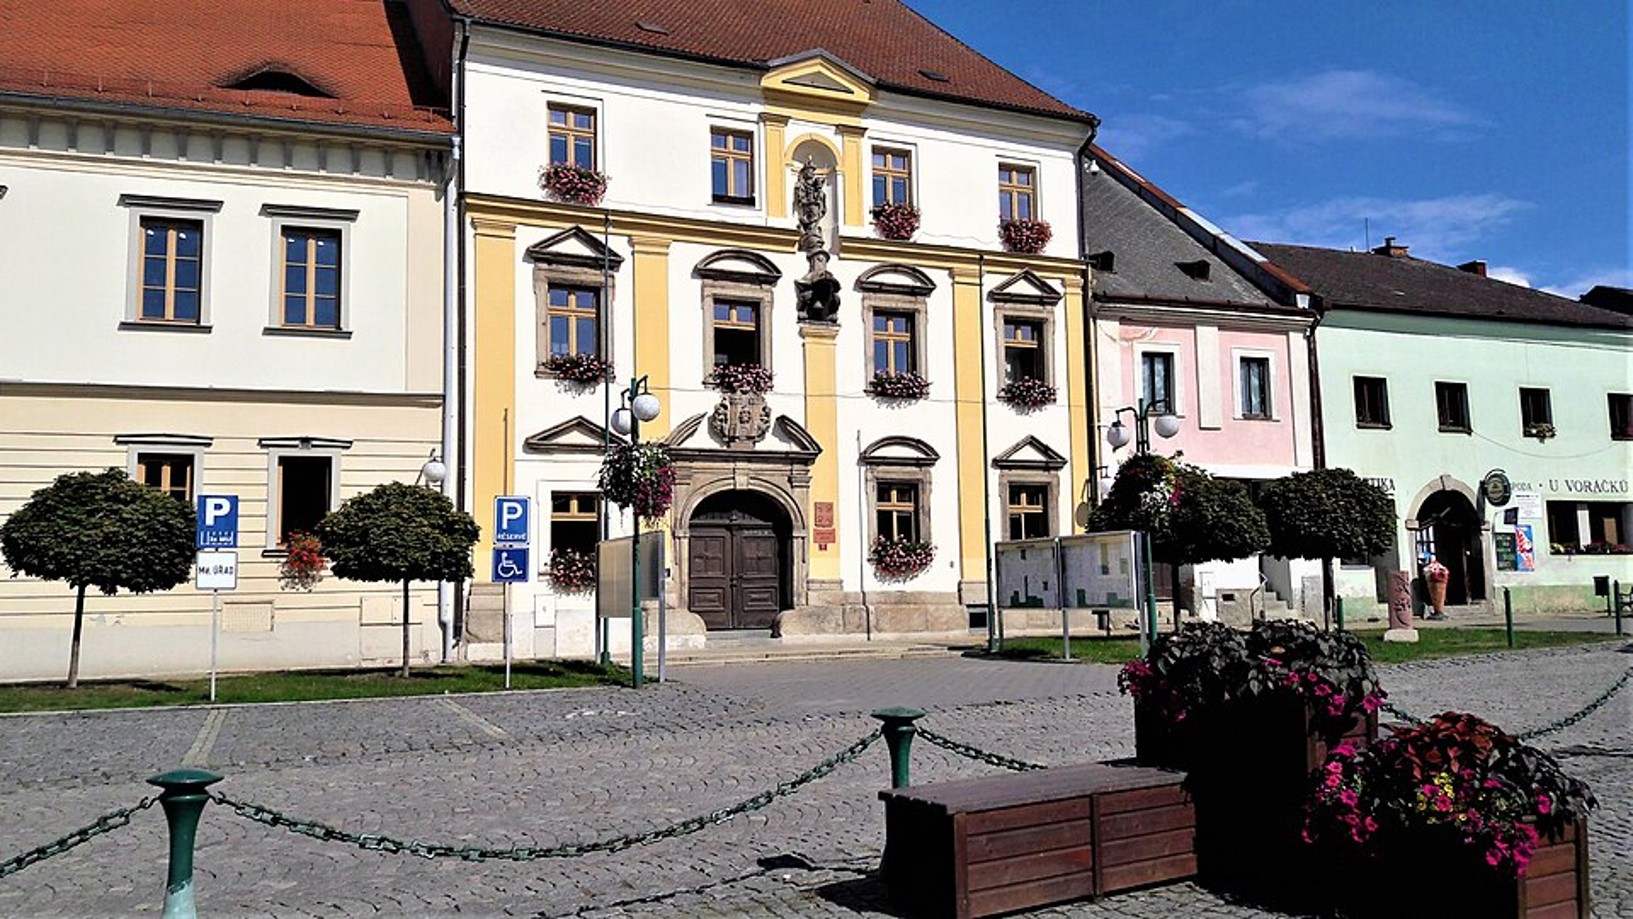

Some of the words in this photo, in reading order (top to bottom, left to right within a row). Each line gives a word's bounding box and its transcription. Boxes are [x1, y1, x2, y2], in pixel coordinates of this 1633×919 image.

[1549, 479, 1559, 492] U
[205, 498, 231, 526] P
[502, 501, 523, 530] P
